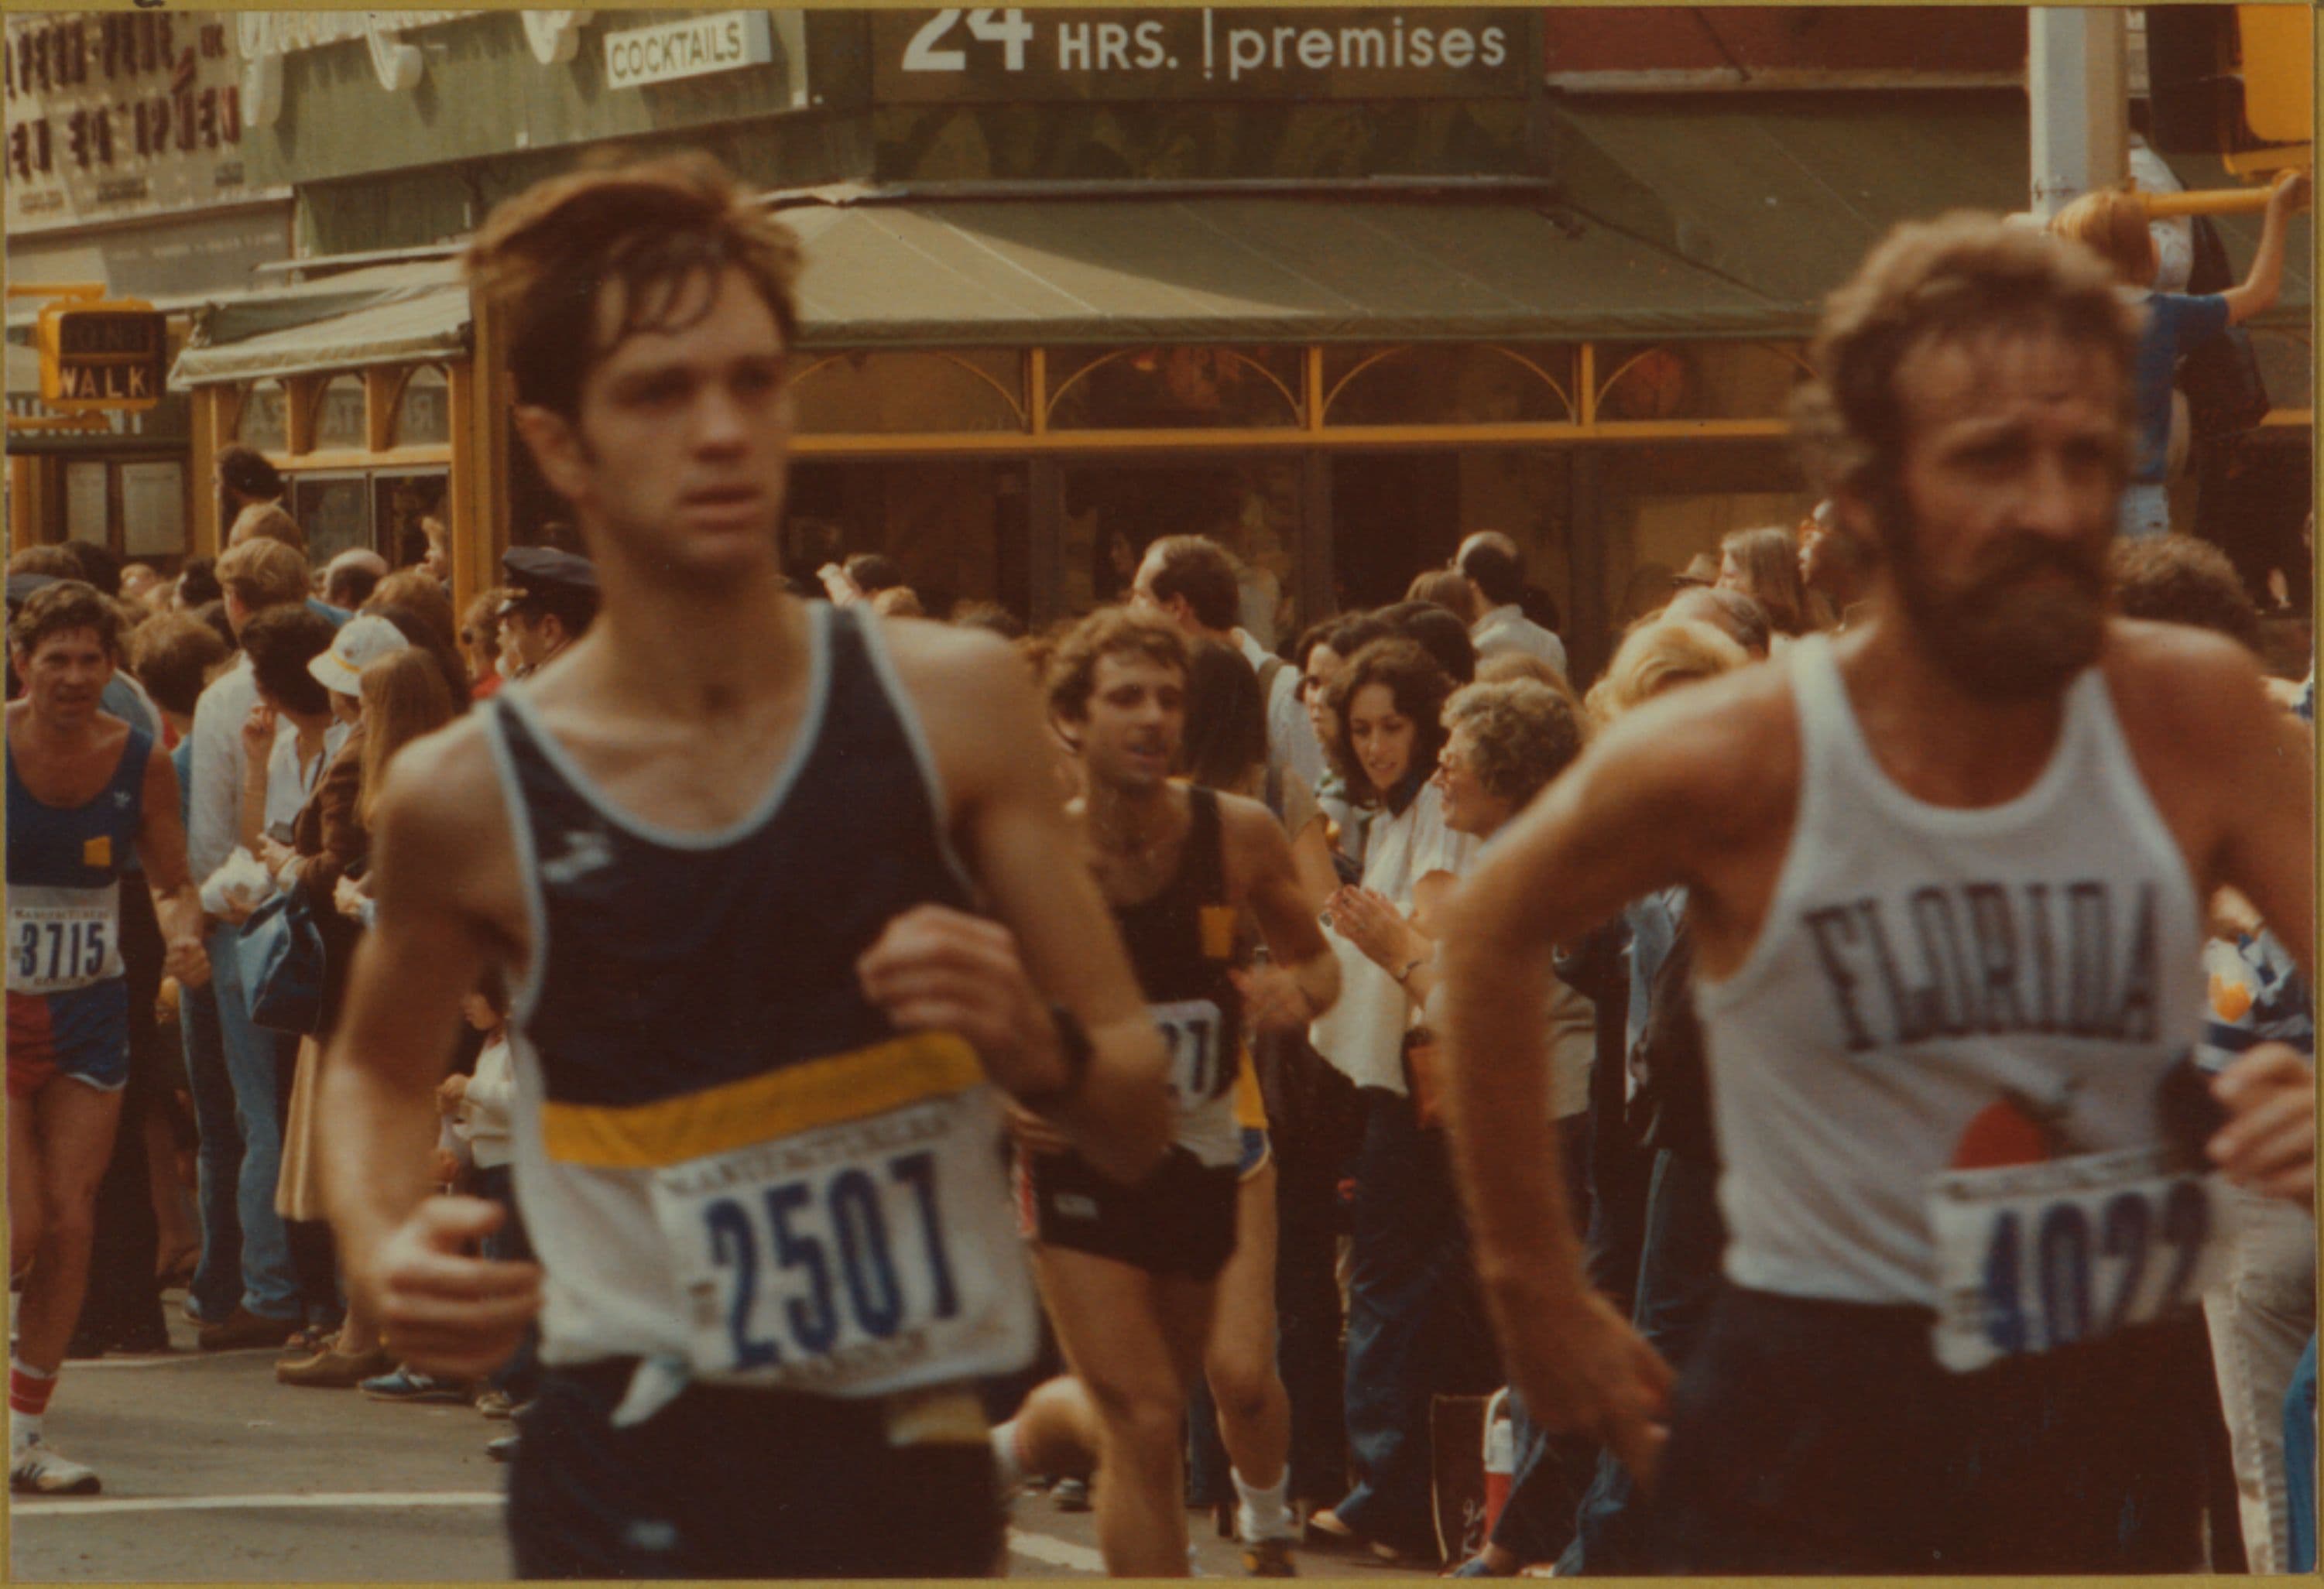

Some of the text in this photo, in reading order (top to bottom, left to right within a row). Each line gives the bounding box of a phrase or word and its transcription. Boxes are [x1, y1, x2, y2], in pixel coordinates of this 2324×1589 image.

[610, 22, 742, 80] COCKTAILS
[902, 9, 1506, 80] 24 HRS. premises
[61, 365, 147, 397] WALK
[22, 923, 105, 978] 3715
[1802, 881, 2161, 1051] FLORIDA
